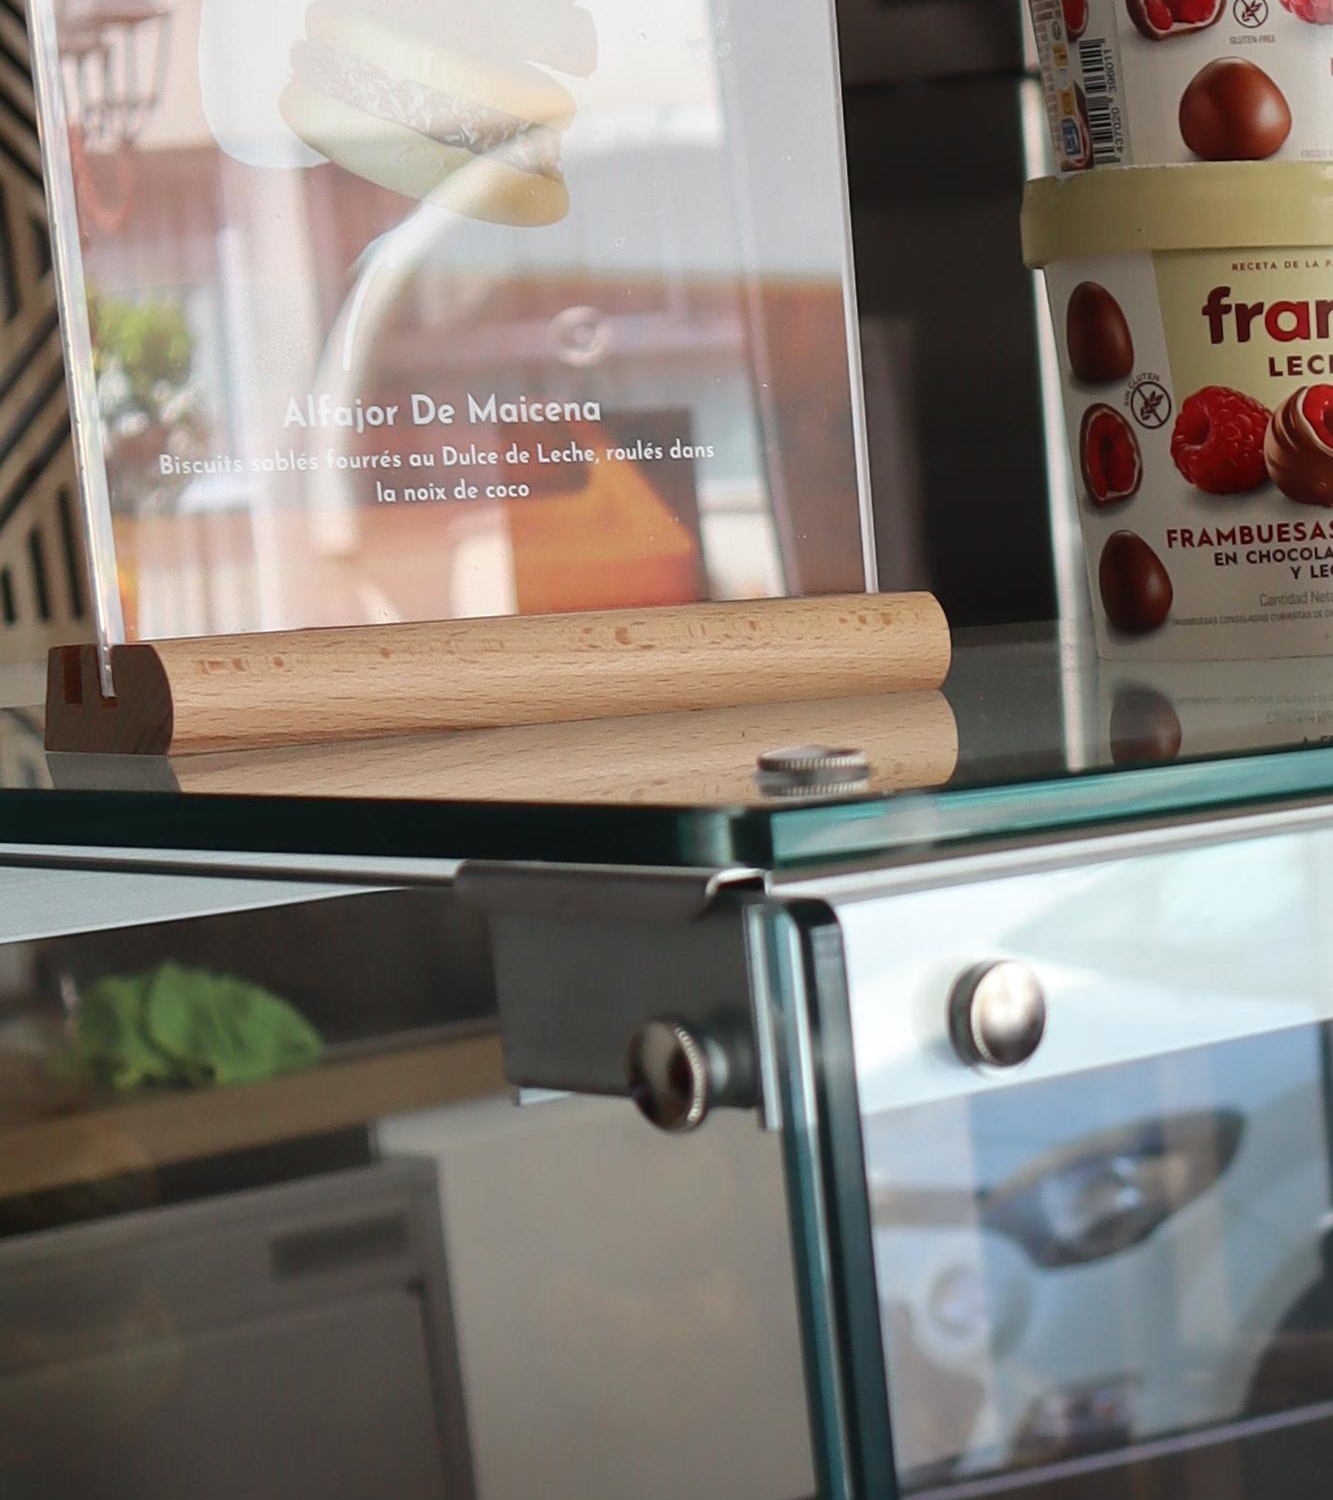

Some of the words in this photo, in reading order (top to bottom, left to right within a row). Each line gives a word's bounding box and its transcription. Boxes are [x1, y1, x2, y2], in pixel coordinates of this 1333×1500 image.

[1229, 35, 1276, 45] GLUTEN-FREE
[1232, 262, 1278, 271] RECETA
[1284, 261, 1298, 269] DE
[1305, 259, 1319, 268] LA
[283, 394, 398, 432] Alfajor
[412, 394, 456, 426] De
[468, 394, 602, 424] Maicena
[159, 451, 243, 476] Biscuits
[250, 448, 319, 473] sablés
[326, 447, 402, 470] fourrés
[409, 452, 436, 468] au
[442, 445, 498, 467] Dulce
[505, 443, 531, 464] de
[537, 442, 601, 466] Leche,
[605, 440, 664, 462] roulés
[669, 438, 716, 460] dans
[376, 481, 396, 503] la
[404, 481, 446, 502] noix
[454, 479, 478, 500] de
[485, 482, 531, 500] coco
[1214, 552, 1237, 566] EN
[1291, 565, 1302, 580] Y
[1259, 590, 1308, 606] Cantidad
